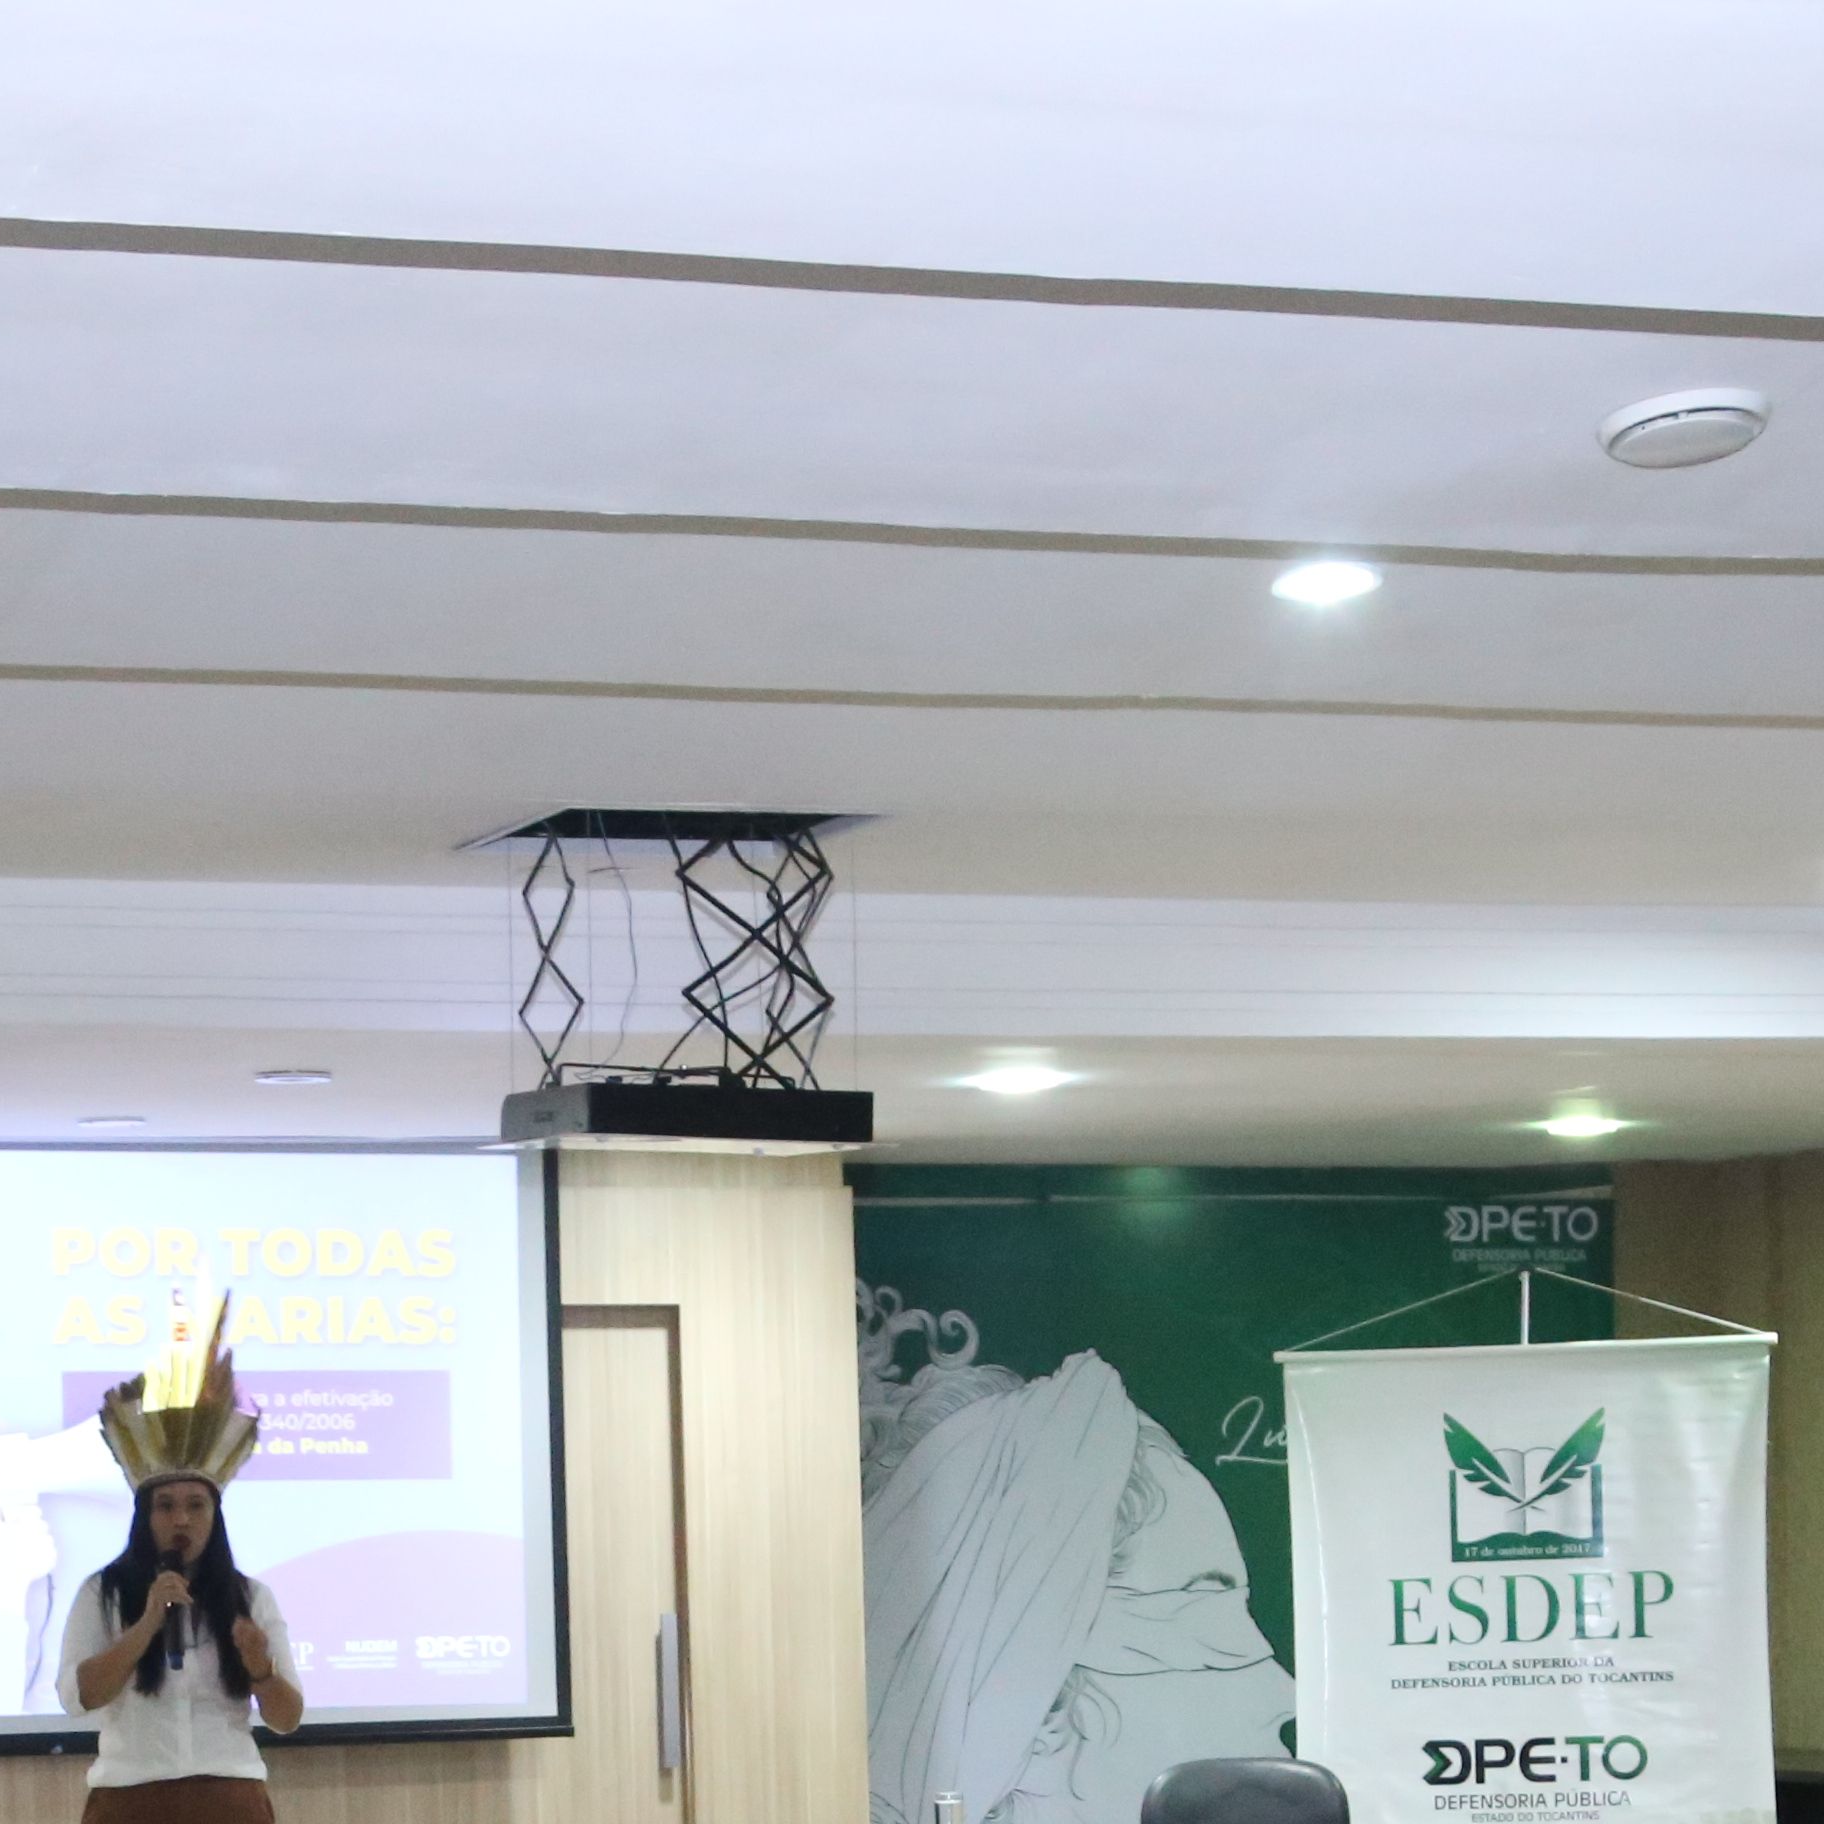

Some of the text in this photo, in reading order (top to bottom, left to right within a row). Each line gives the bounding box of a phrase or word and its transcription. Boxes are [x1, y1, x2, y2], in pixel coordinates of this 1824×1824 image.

[54, 1228, 457, 1278] POR TODAS
[53, 1295, 457, 1345] AS ARIAS:
[300, 1436, 369, 1455] Penha
[1388, 1569, 1675, 1646] ESDEP
[1447, 1656, 1615, 1672] ESCOLA SUPERIOR DA
[1390, 1677, 1488, 1690] DEFENSORIA
[1561, 1673, 1583, 1685] DO
[1589, 1670, 1675, 1684] TOCANTINS
[1434, 1793, 1548, 1811] DEFENSORIA
[1471, 1809, 1600, 1824] ESTADO DO TOCANTINS
